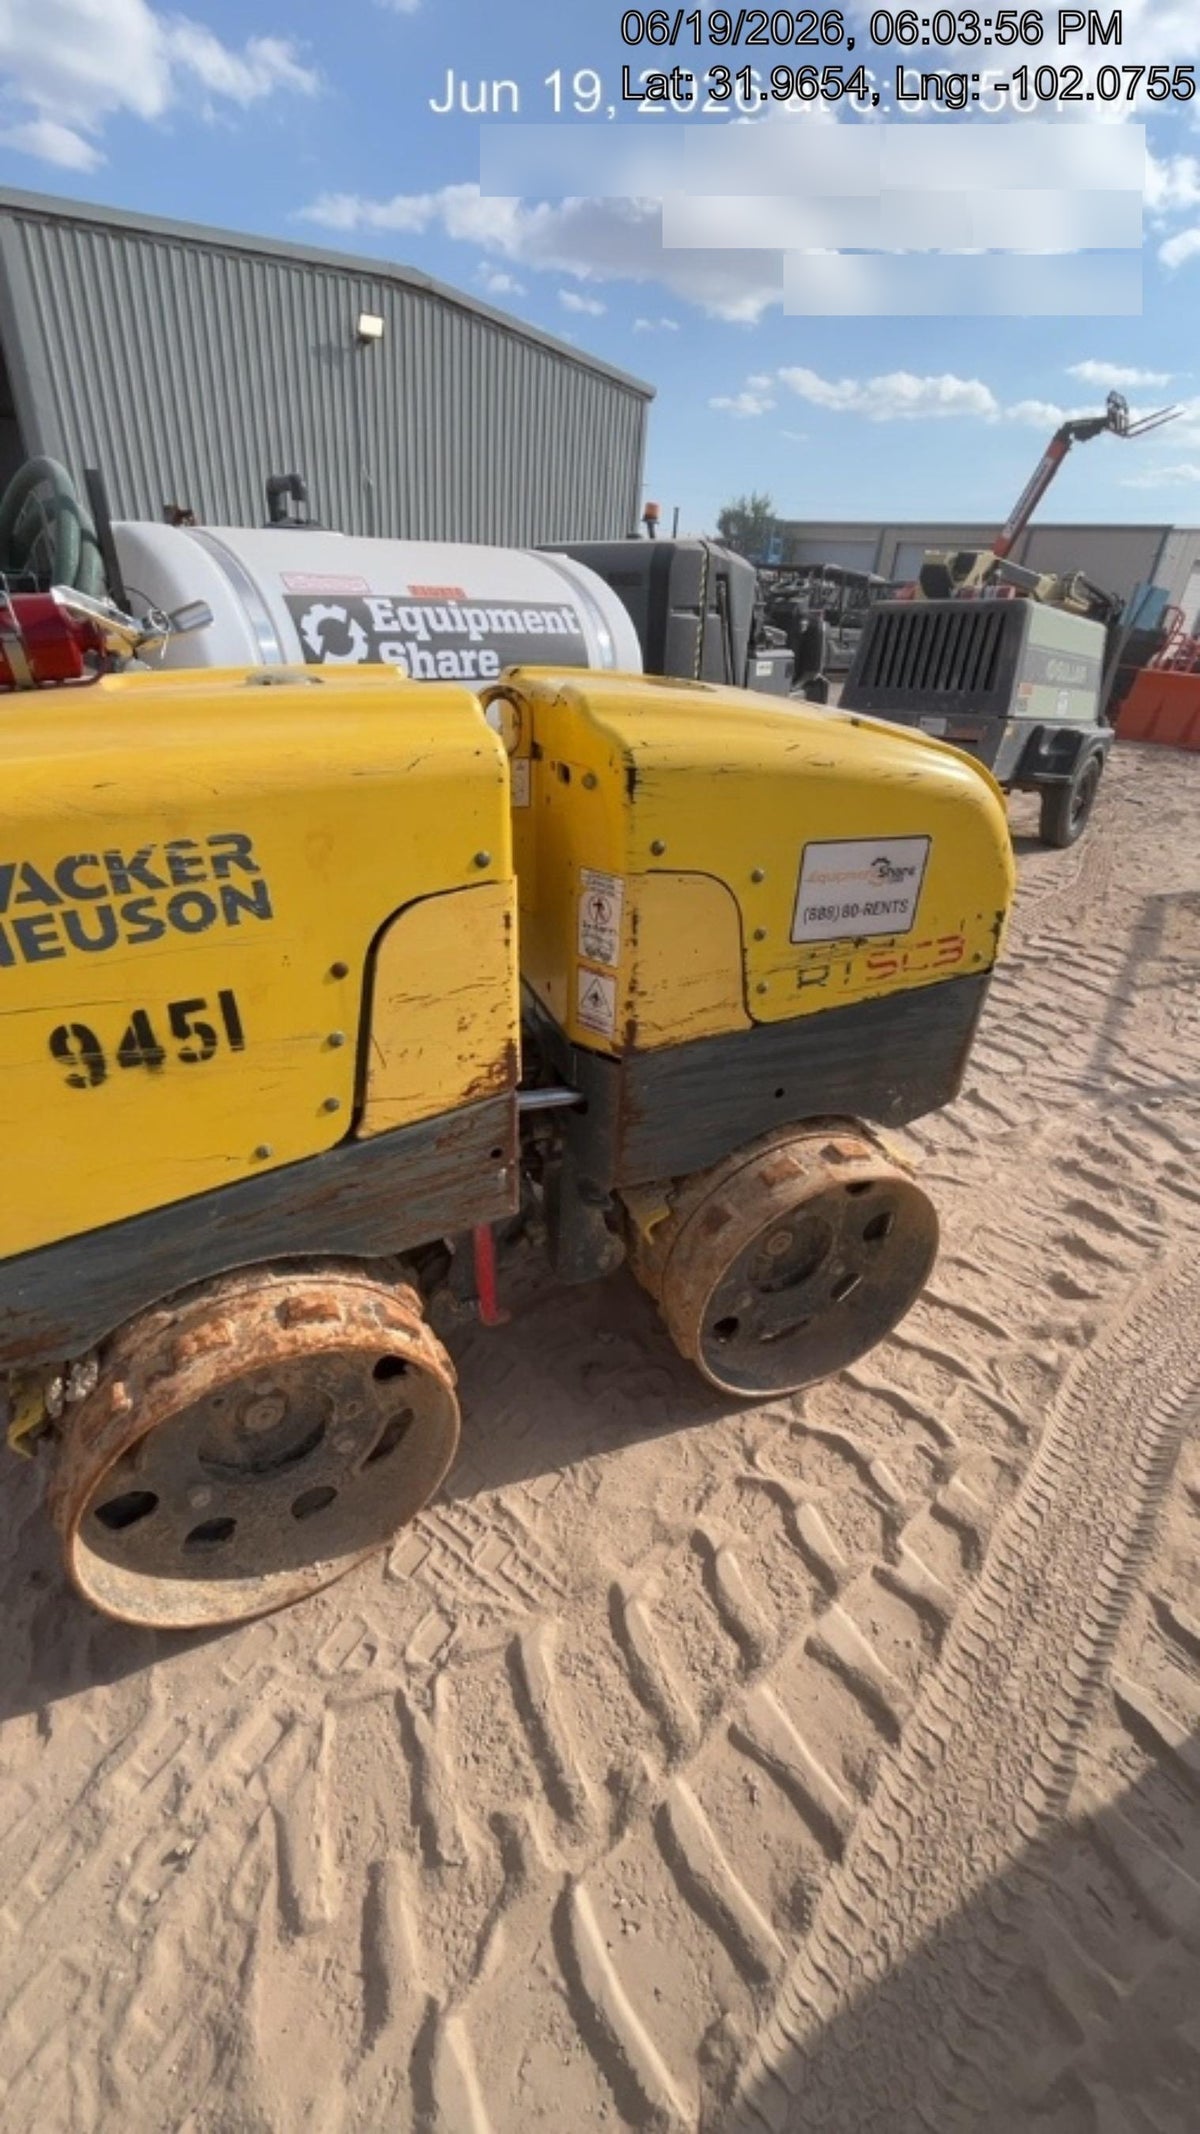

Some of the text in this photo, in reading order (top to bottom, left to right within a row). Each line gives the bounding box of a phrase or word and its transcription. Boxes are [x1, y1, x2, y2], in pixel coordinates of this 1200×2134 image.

[362, 597, 582, 641] Equipment
[378, 641, 500, 680] Share
[49, 988, 245, 1090] 9451
